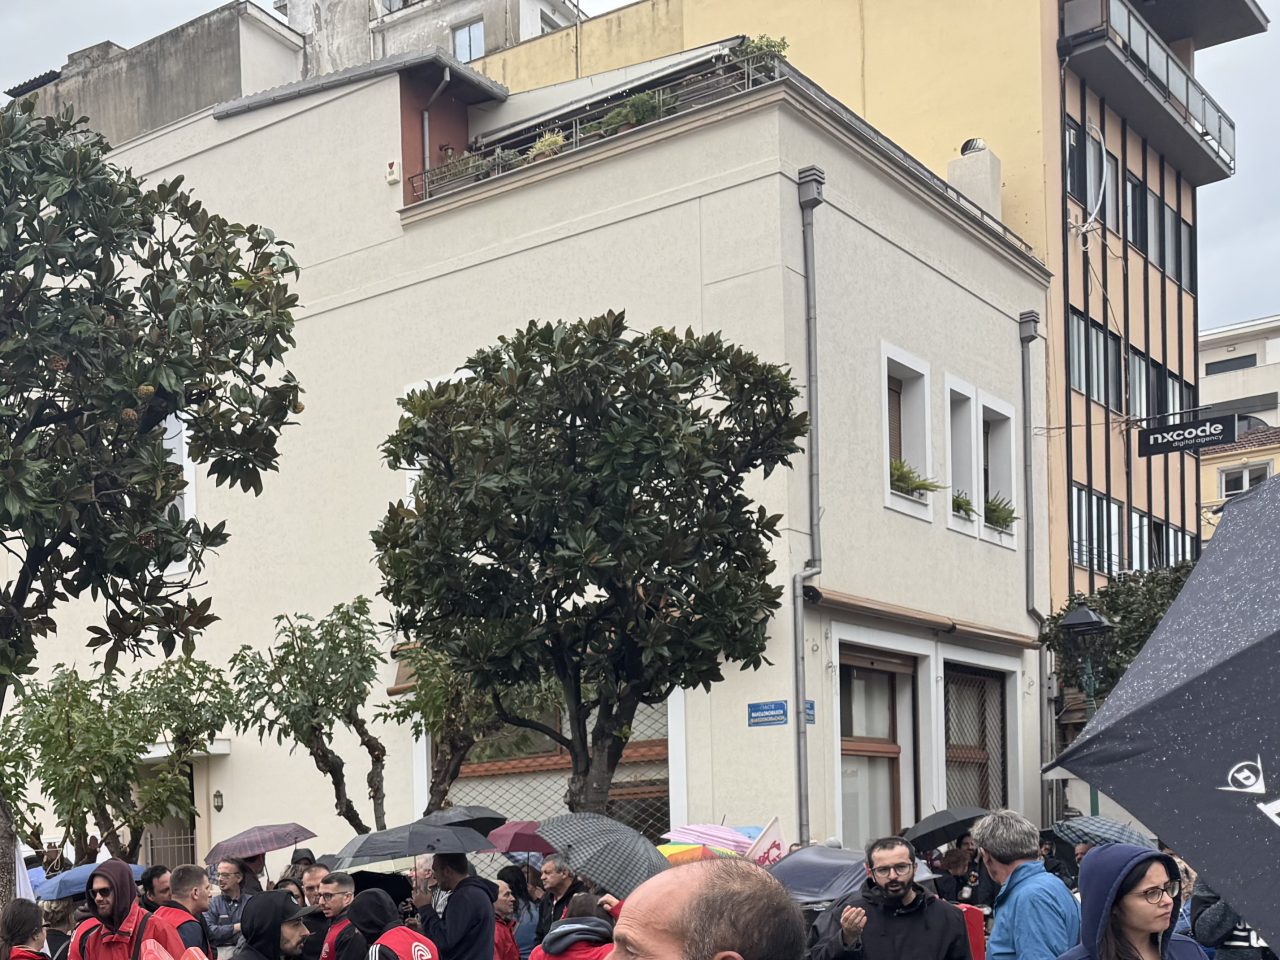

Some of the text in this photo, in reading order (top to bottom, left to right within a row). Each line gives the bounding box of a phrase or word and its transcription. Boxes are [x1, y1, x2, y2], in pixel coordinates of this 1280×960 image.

[1150, 422, 1223, 445] nxcode
[1172, 434, 1224, 447] digital agency
